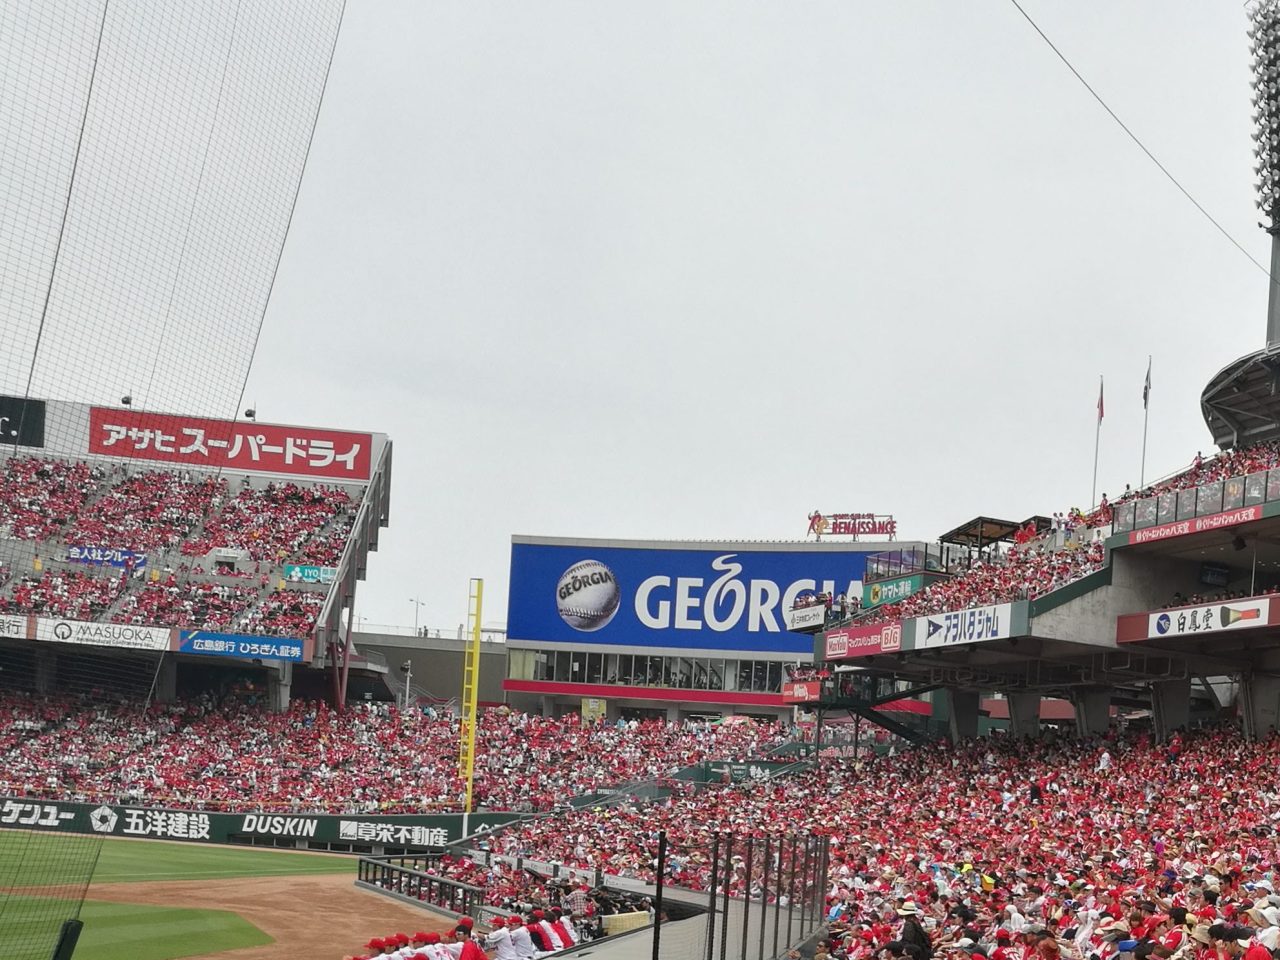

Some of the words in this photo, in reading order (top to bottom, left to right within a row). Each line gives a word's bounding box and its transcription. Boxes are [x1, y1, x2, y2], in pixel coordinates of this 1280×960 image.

[103, 424, 360, 470] アサヒスーパードライ
[832, 520, 897, 534] RENAISSANCE
[305, 568, 319, 578] IYO
[945, 605, 999, 643] アヲハタジャム
[1177, 607, 1212, 634] 白鳳堂
[76, 625, 154, 642] MASUOKA
[193, 640, 236, 653] 広島銀行
[240, 642, 301, 658] ひろぎん証券
[123, 808, 210, 840] 五洋建設
[241, 814, 318, 837] DUSKIN
[357, 822, 448, 847] 章栄不動産
